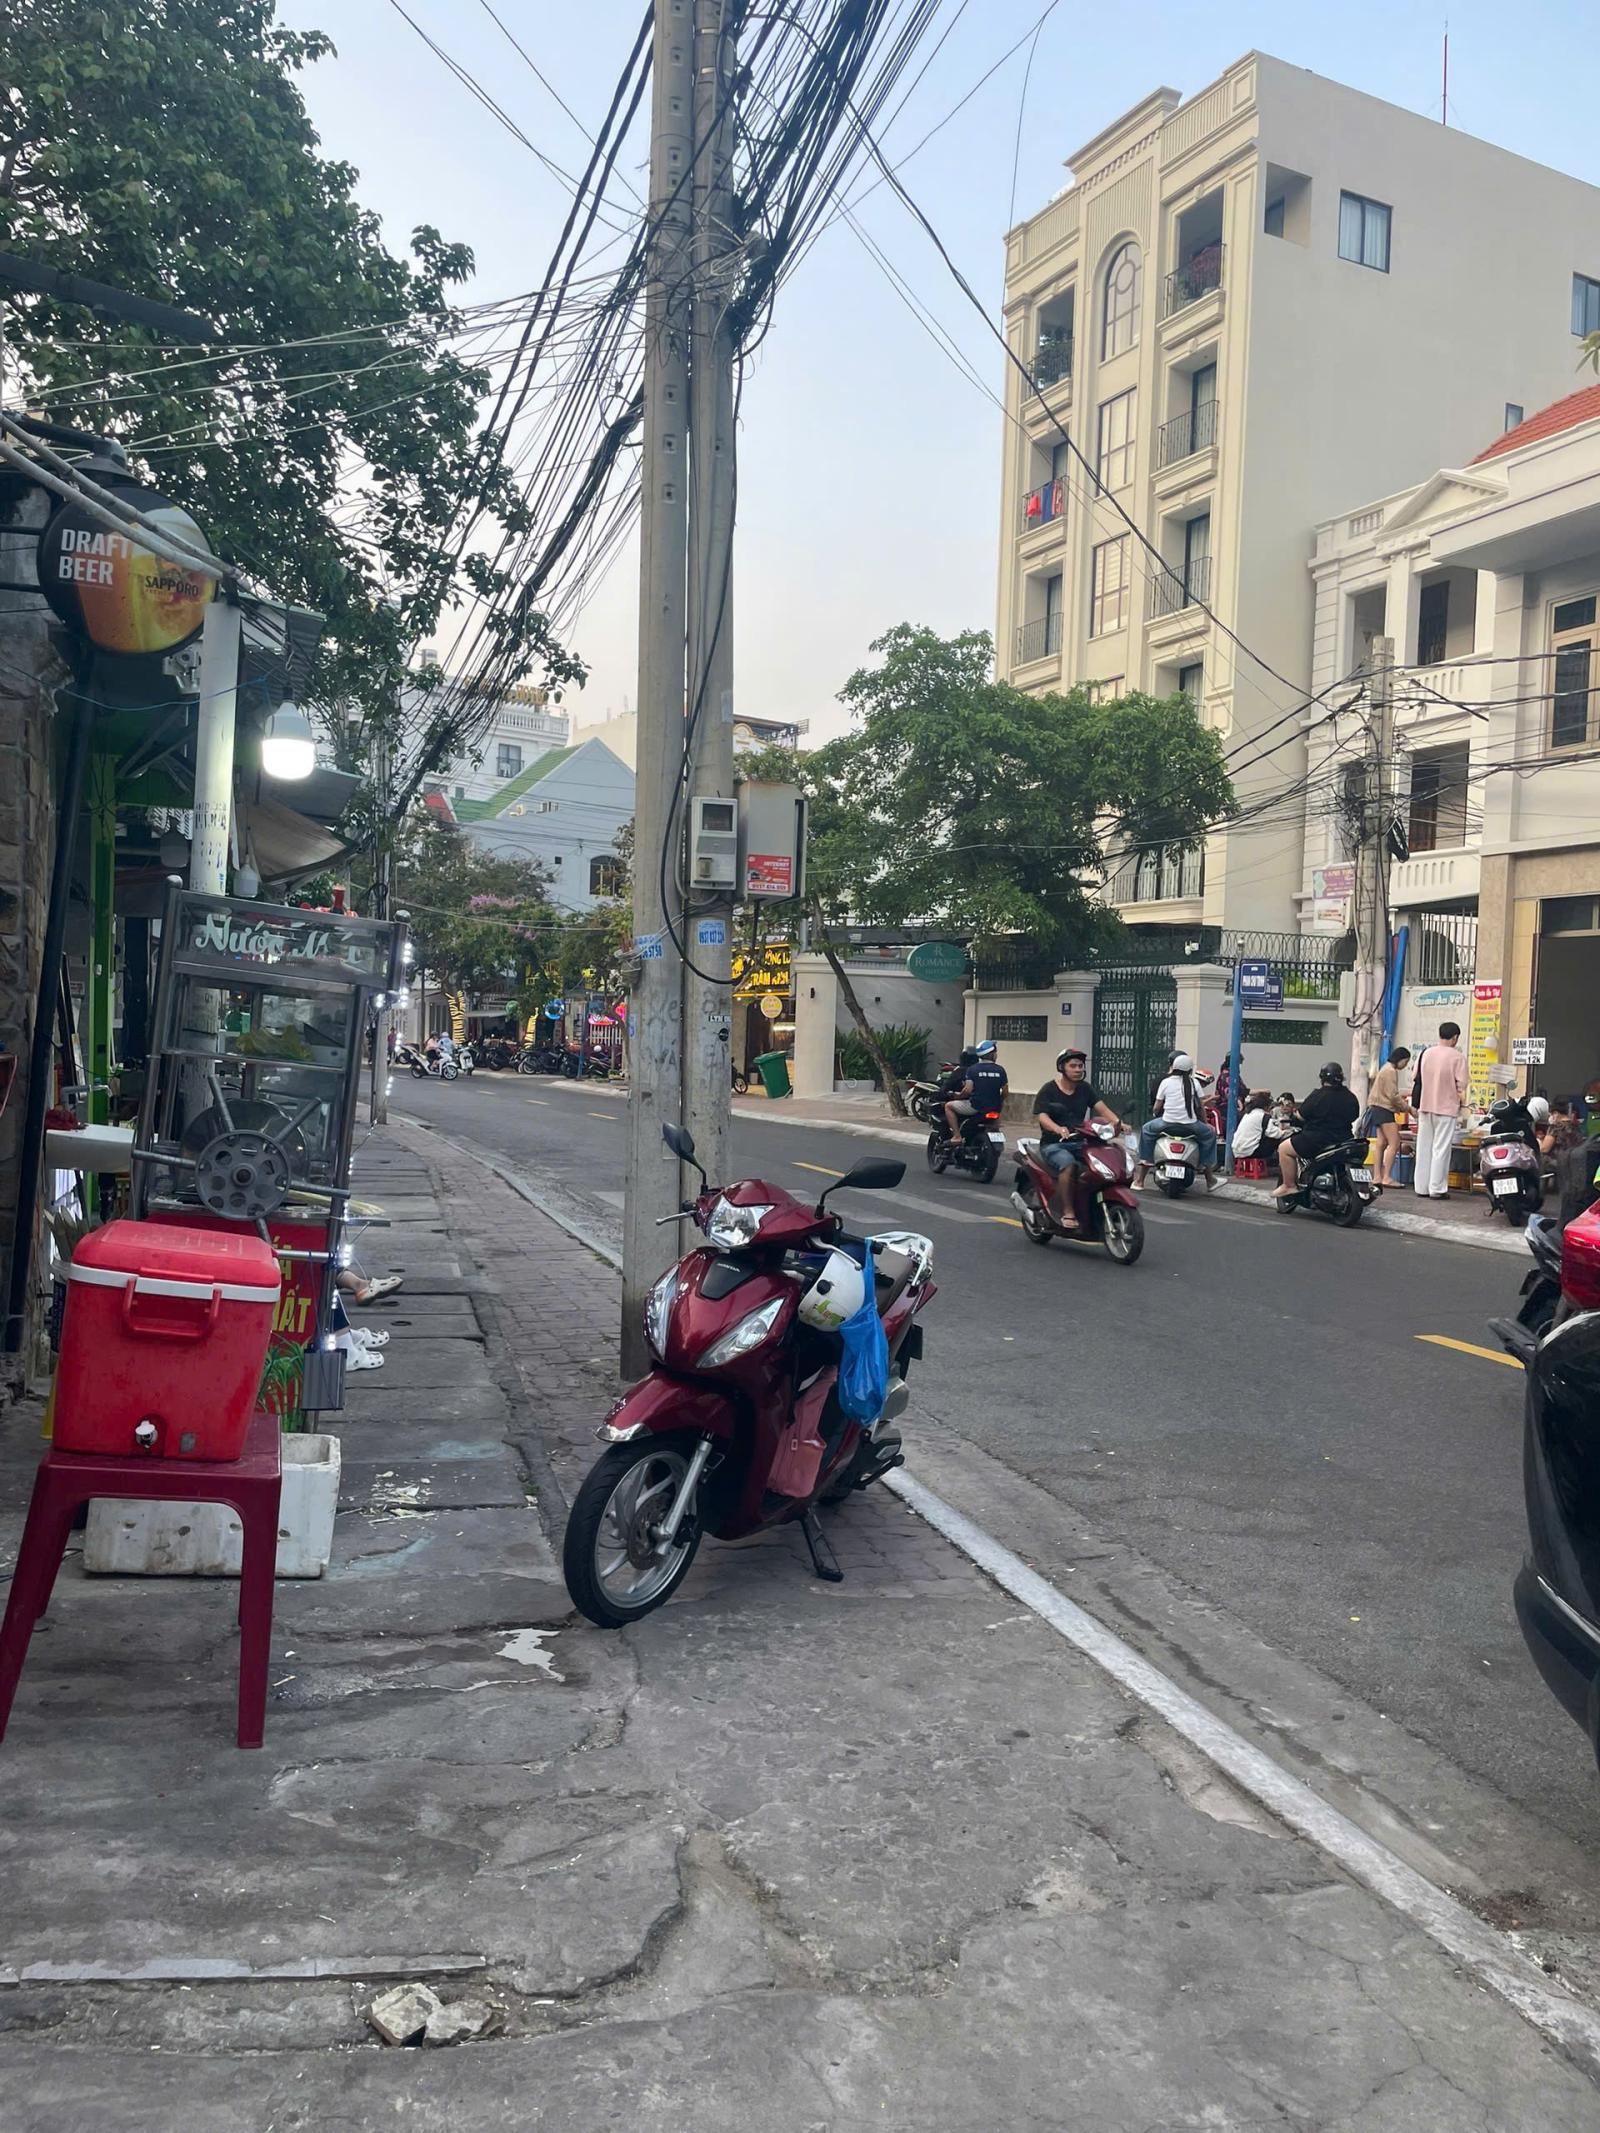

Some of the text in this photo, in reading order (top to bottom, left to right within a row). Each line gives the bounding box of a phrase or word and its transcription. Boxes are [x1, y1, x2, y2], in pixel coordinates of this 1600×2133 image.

[61, 529, 130, 559] DRAFT
[59, 555, 114, 585] BEER
[145, 575, 199, 597] SAPPORO
[915, 956, 962, 967] ROMANCE
